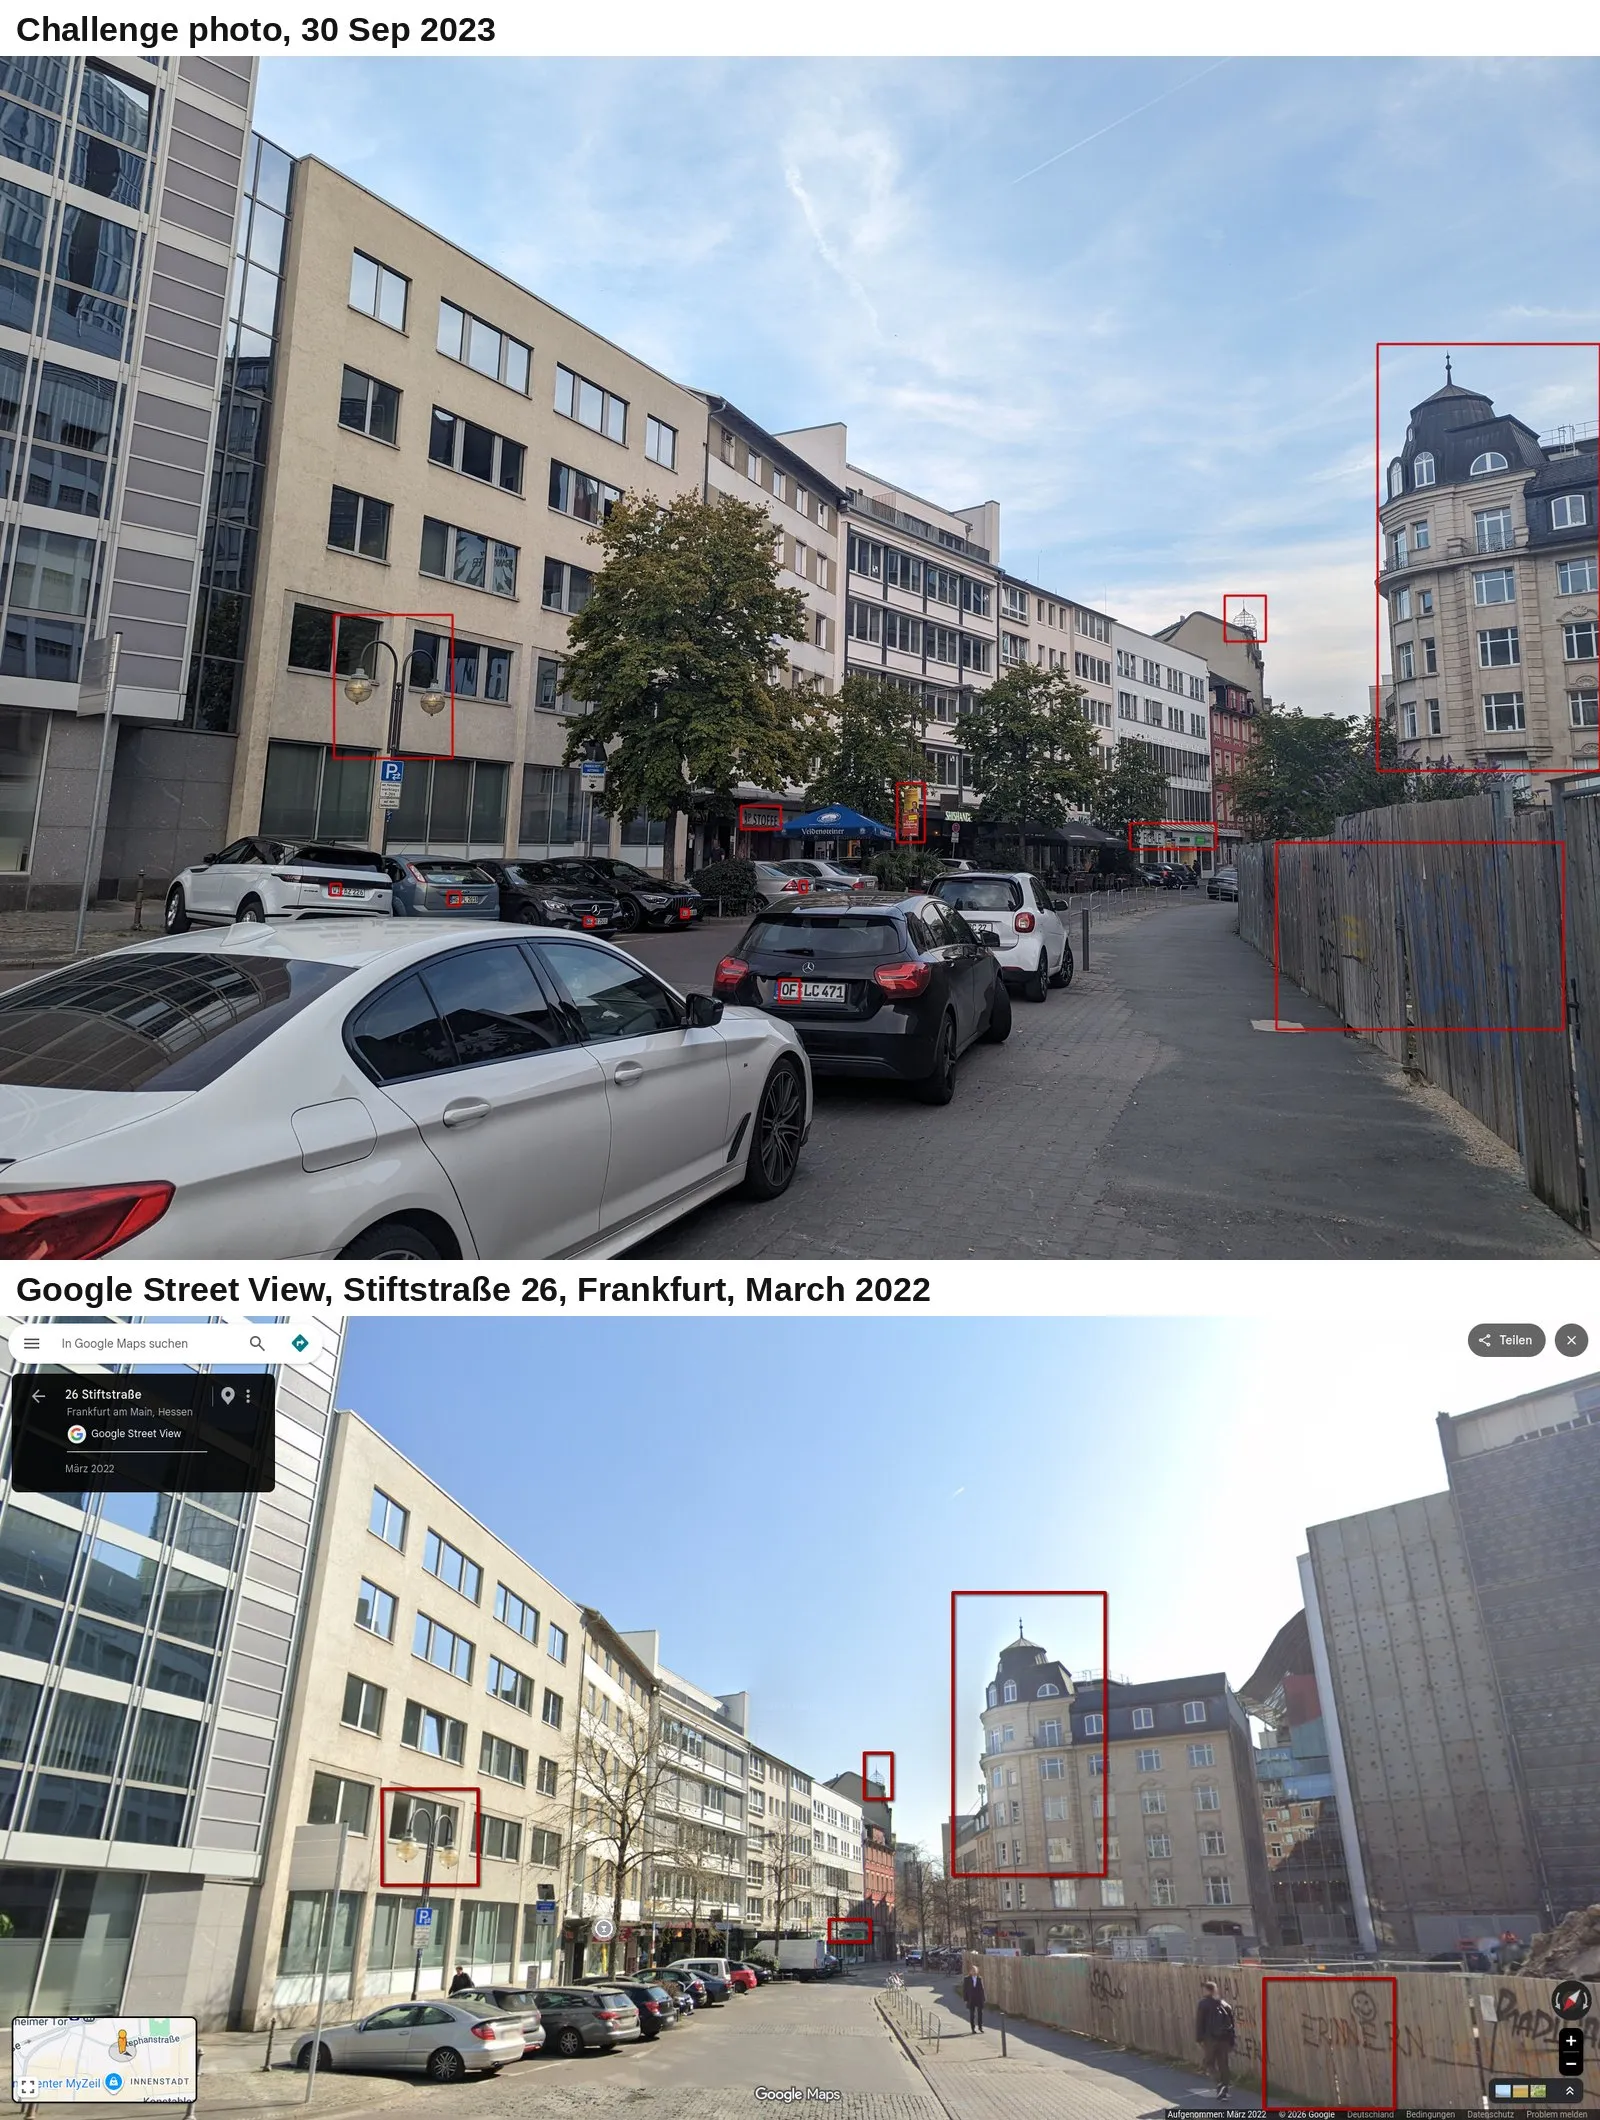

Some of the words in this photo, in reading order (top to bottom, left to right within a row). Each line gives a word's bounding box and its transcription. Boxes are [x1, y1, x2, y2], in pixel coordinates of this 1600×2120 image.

[385, 763, 398, 779] P
[782, 983, 798, 996] OF
[804, 984, 819, 997] LC
[822, 985, 844, 998] 471
[419, 1910, 429, 1924] P
